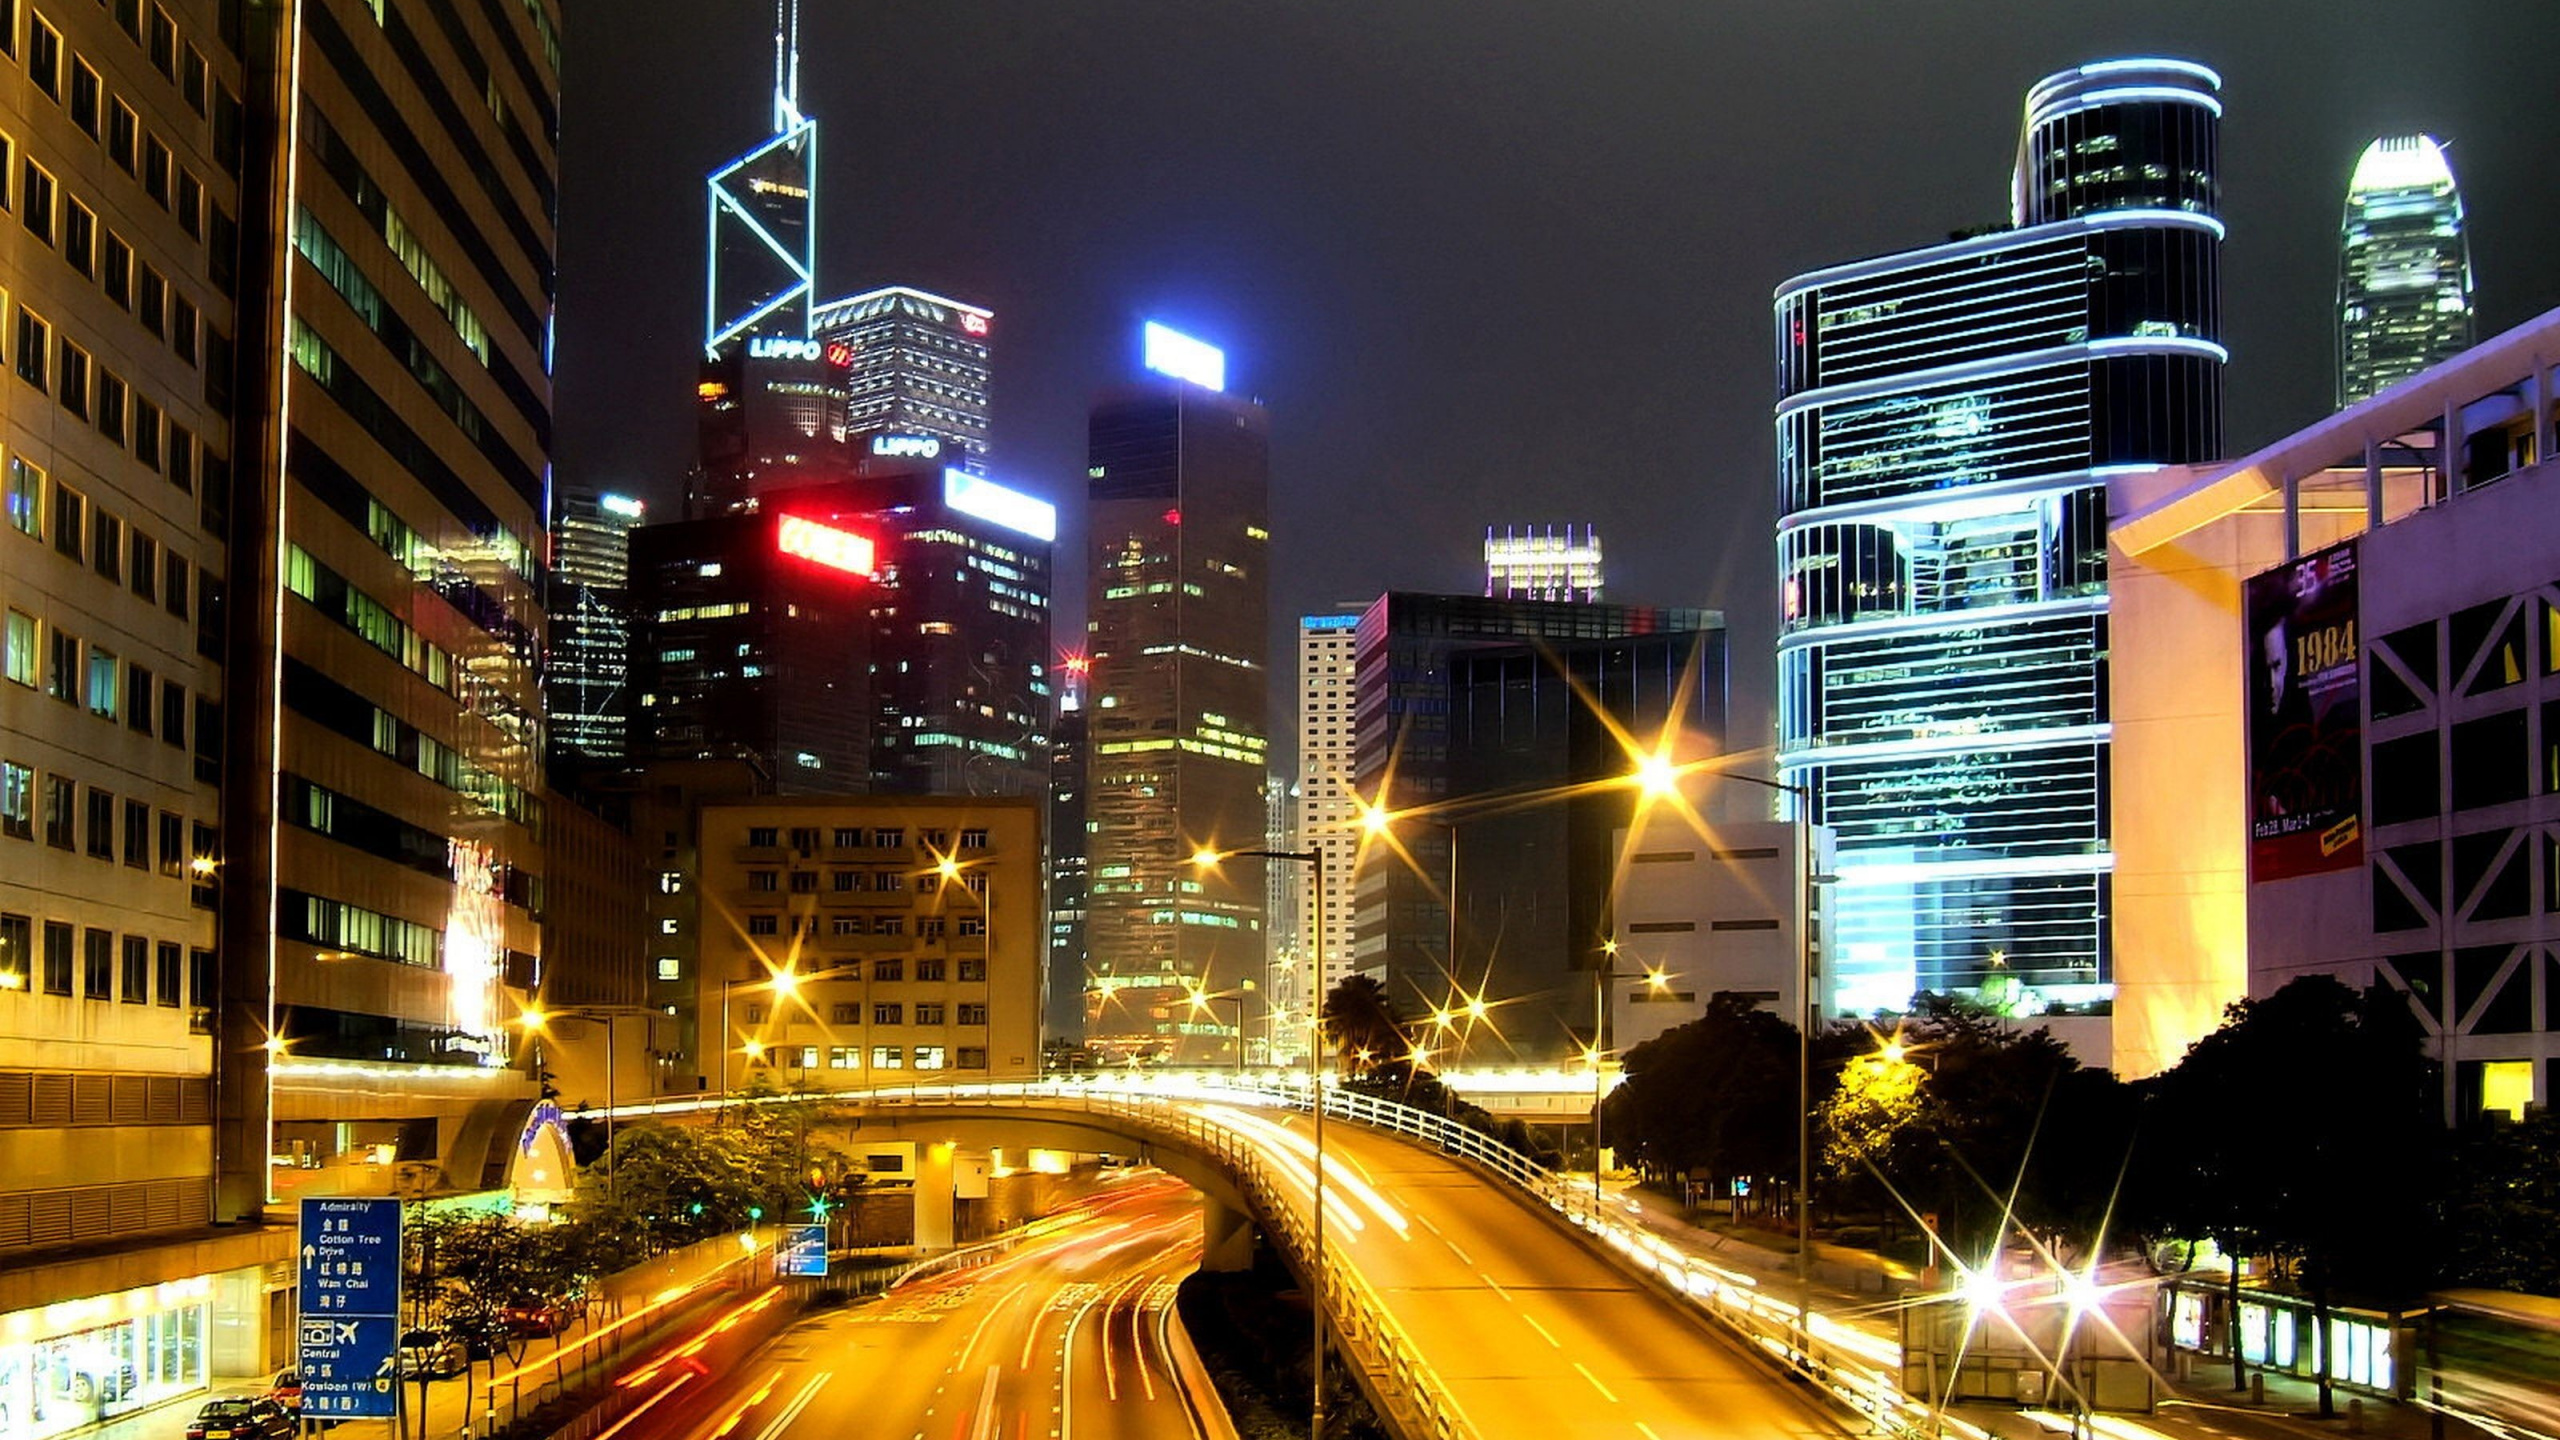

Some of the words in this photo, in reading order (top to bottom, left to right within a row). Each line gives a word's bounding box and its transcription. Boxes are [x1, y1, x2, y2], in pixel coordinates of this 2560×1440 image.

[750, 338, 821, 361] LIPPO
[873, 436, 940, 458] LIPPO
[2297, 620, 2356, 676] 1984
[319, 1202, 371, 1214] Admiralty
[319, 1234, 355, 1245] Cotton
[358, 1234, 382, 1245] Tree
[319, 1246, 345, 1256] Drive
[318, 1278, 341, 1289] Wan
[345, 1278, 369, 1289] Chai
[301, 1348, 340, 1359] Central
[301, 1381, 348, 1392] Kowloon
